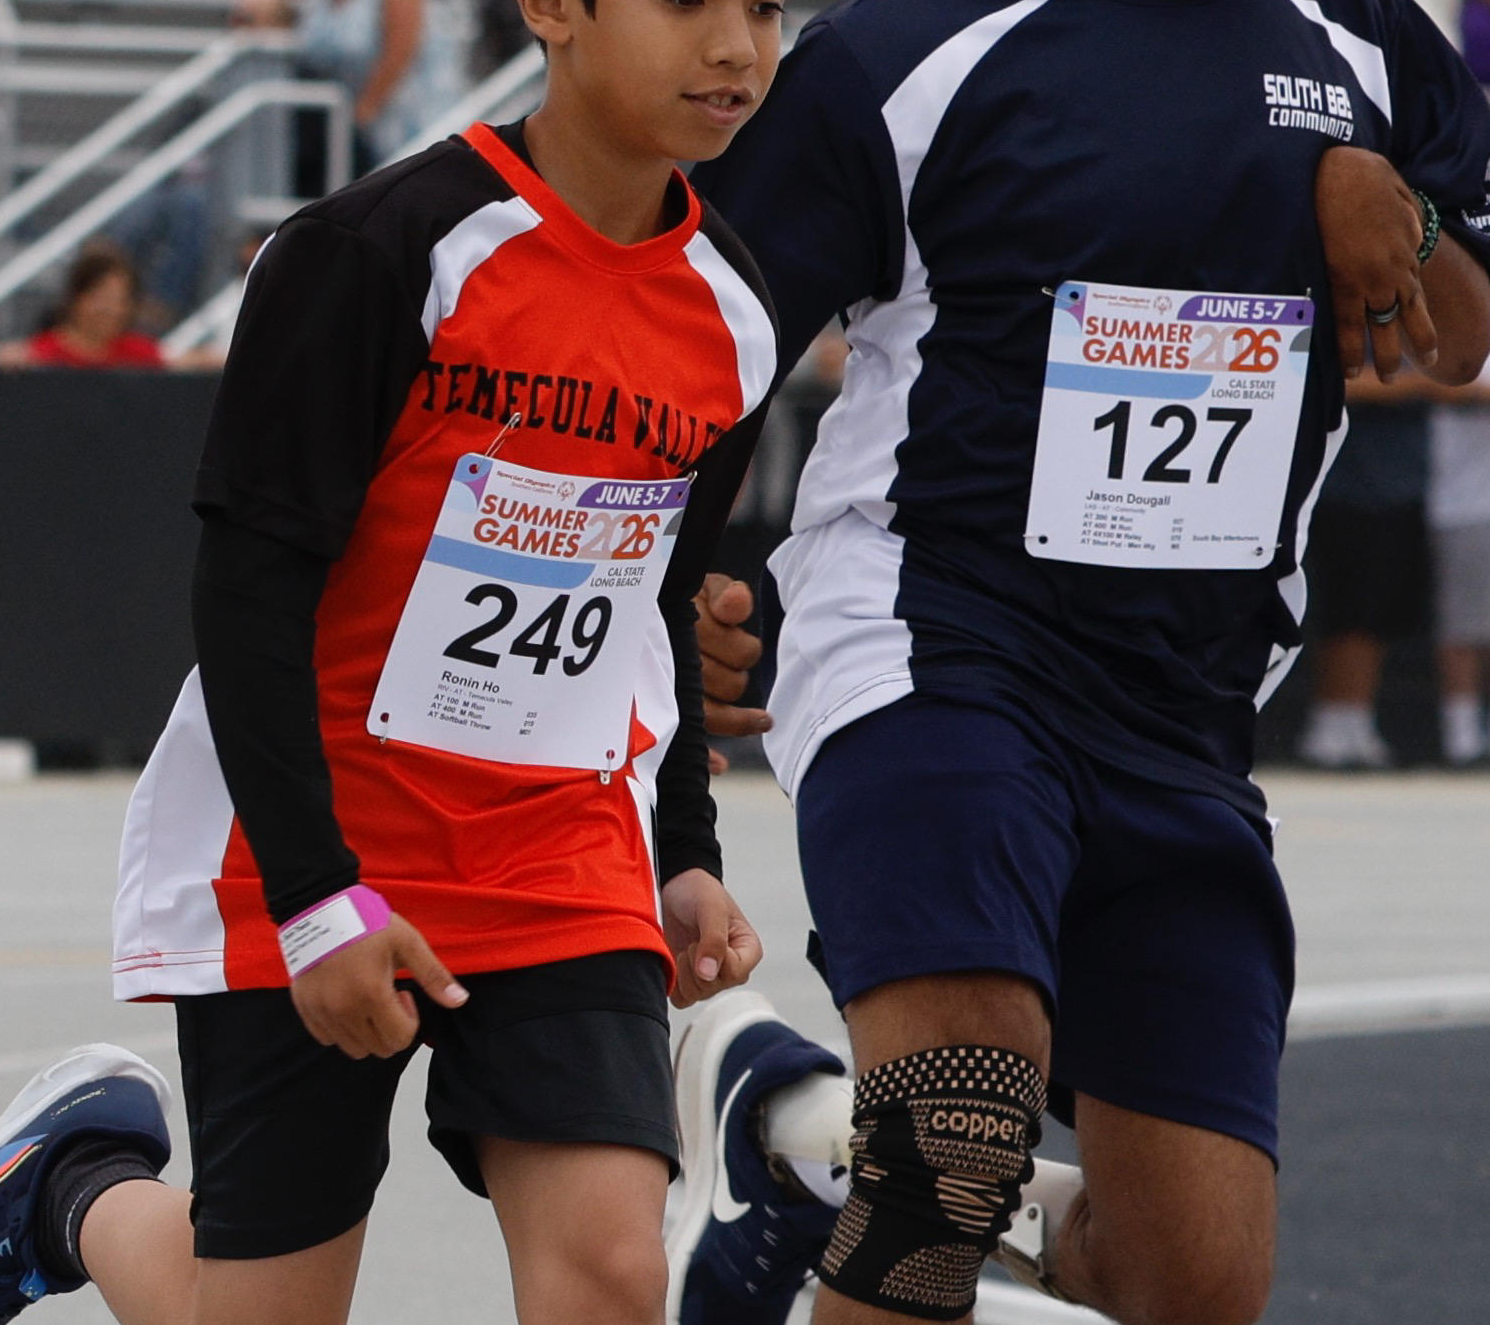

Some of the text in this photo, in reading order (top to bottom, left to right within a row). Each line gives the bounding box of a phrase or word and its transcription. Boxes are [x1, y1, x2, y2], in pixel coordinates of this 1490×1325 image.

[1263, 74, 1322, 111] SOUTH
[1197, 298, 1286, 320] JUNE 5-7
[1082, 339, 1190, 369] GAMES
[1085, 316, 1281, 373] SUMMER 2026
[1211, 388, 1274, 400] LONG BEACH
[1229, 379, 1276, 390] CAL STATE
[420, 361, 618, 444] TEMECULA
[1093, 401, 1252, 484] 127
[595, 485, 670, 506] JUNE 5-7
[1086, 490, 1171, 507] Jason Dougall
[473, 518, 582, 558] GAMES
[481, 494, 660, 560] SUMMER 2026
[590, 577, 642, 587] LONG BEACH
[608, 566, 646, 577] CAL STATE
[443, 583, 613, 677] 249
[441, 670, 500, 693] Ronin Ho
[931, 1111, 1025, 1144] copper
